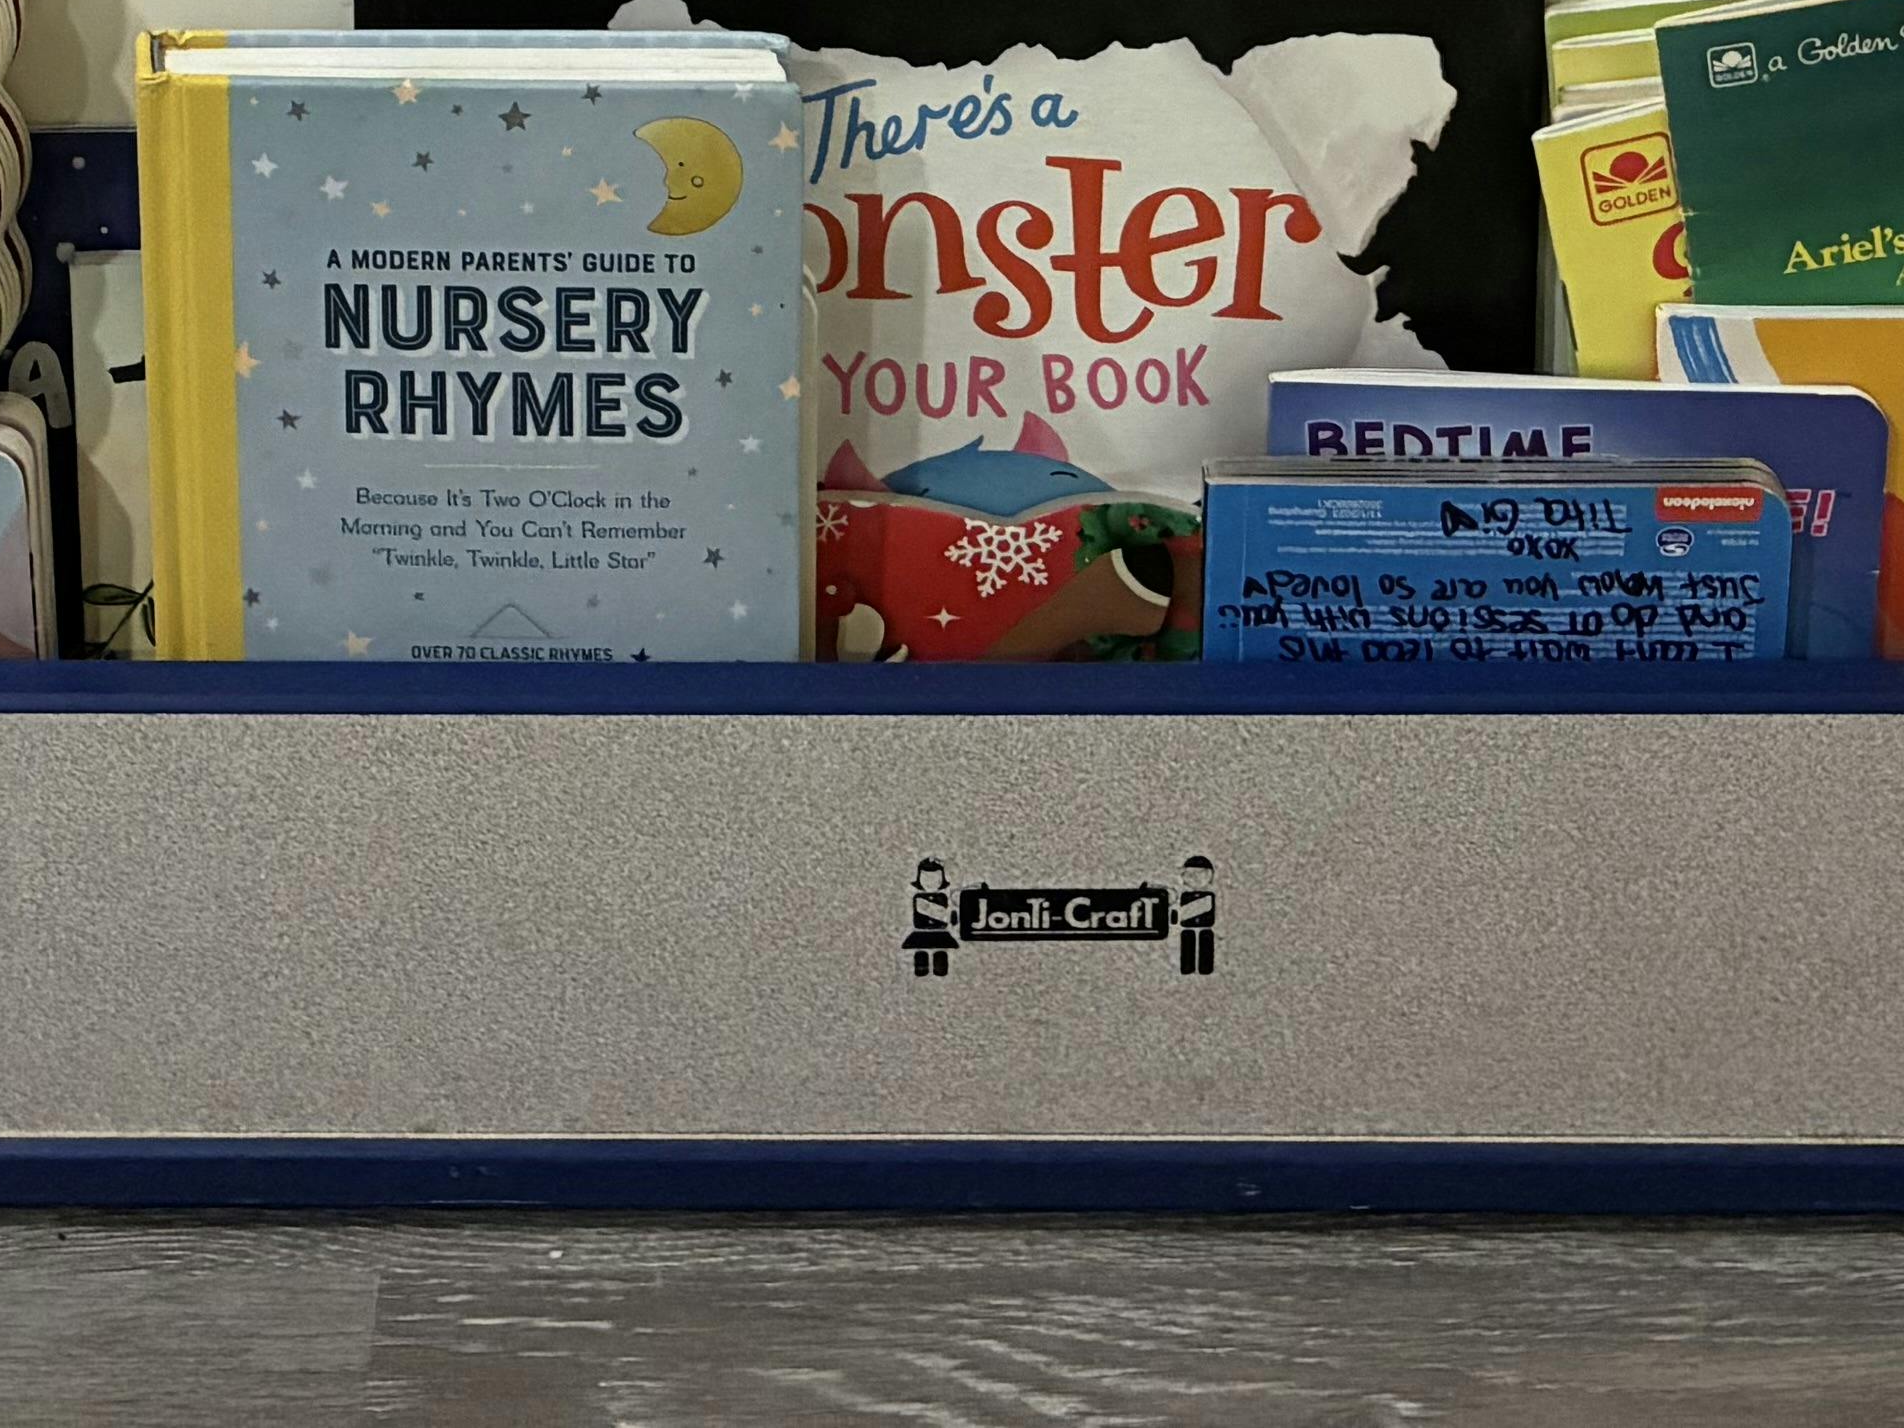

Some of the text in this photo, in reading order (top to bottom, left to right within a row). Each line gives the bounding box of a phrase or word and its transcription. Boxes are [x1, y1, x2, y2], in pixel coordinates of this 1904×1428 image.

[1768, 55, 1788, 72] a
[1797, 31, 1898, 65] Golden
[803, 74, 1080, 183] There's a
[1598, 185, 1672, 214] GOLDEN
[326, 250, 696, 274] A MODERN PARENTS' GUIDE TO
[323, 283, 705, 354] NURSERY
[822, 345, 1209, 419] YOUR BOOK
[345, 369, 683, 438] RHYMES
[356, 488, 671, 509] Because It's Two O'Clock in the
[341, 518, 688, 540] Morning and You Can't Remember
[466, 549, 544, 570] Twinkle,
[552, 550, 600, 569] Little
[1506, 533, 1580, 563] xoxo
[1266, 569, 1364, 608] loved
[1377, 573, 1418, 600] so
[1430, 577, 1488, 601] are
[1503, 571, 1560, 602] you
[1680, 572, 1765, 606] Just
[1302, 601, 1371, 633] with
[1390, 604, 1549, 635] sessions
[1611, 602, 1659, 638] do
[1676, 604, 1747, 638] and
[411, 646, 613, 662] OVER 70 CLASSIC RHYMES
